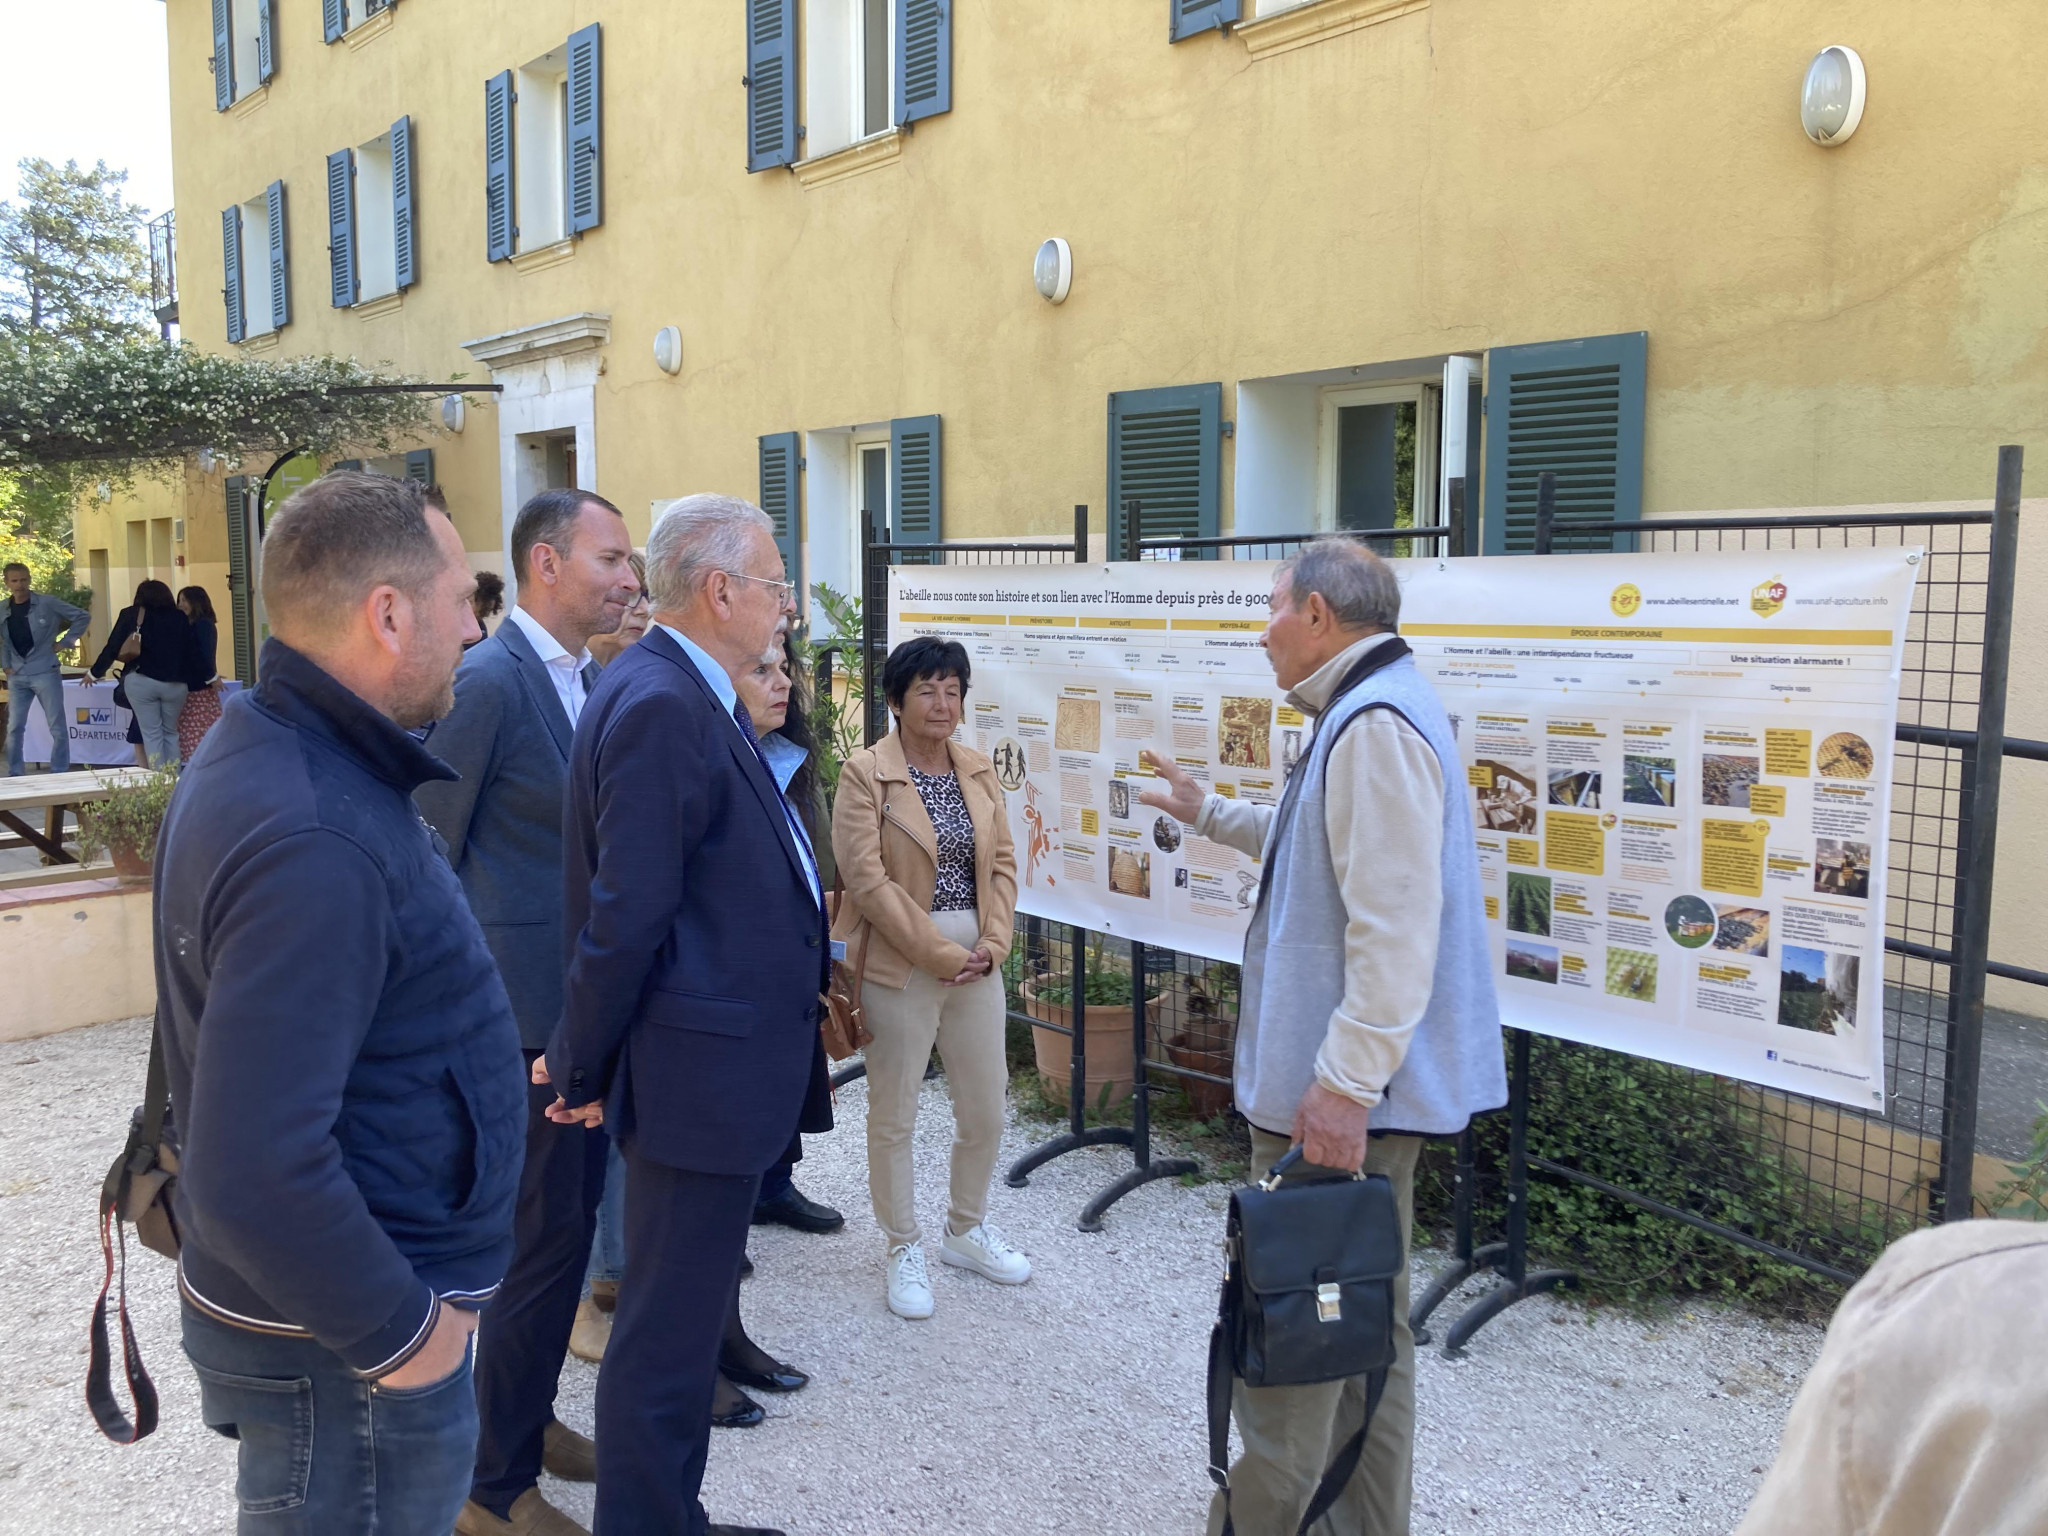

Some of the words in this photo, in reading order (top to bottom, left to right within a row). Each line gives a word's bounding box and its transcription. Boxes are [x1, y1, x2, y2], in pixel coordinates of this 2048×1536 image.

[900, 589, 932, 601] L'abeille
[933, 592, 953, 601] nous
[954, 592, 977, 602] conte
[979, 594, 994, 602] son
[996, 590, 1029, 602] histoire
[1031, 592, 1040, 602] et
[1042, 594, 1058, 603] son
[1060, 590, 1078, 603] lien
[1080, 594, 1102, 603] avec
[1105, 590, 1152, 604] l'Homme
[1156, 590, 1195, 607] depuis
[1197, 590, 1224, 607] près
[1227, 590, 1242, 605] de
[1752, 588, 1784, 598] UNAF
[1484, 648, 1511, 656] l'abeille
[1730, 655, 1748, 663] Une
[1750, 655, 1790, 664] situation
[1793, 656, 1844, 665] alarmante
[70, 726, 130, 741] DÉPARTEMEN
